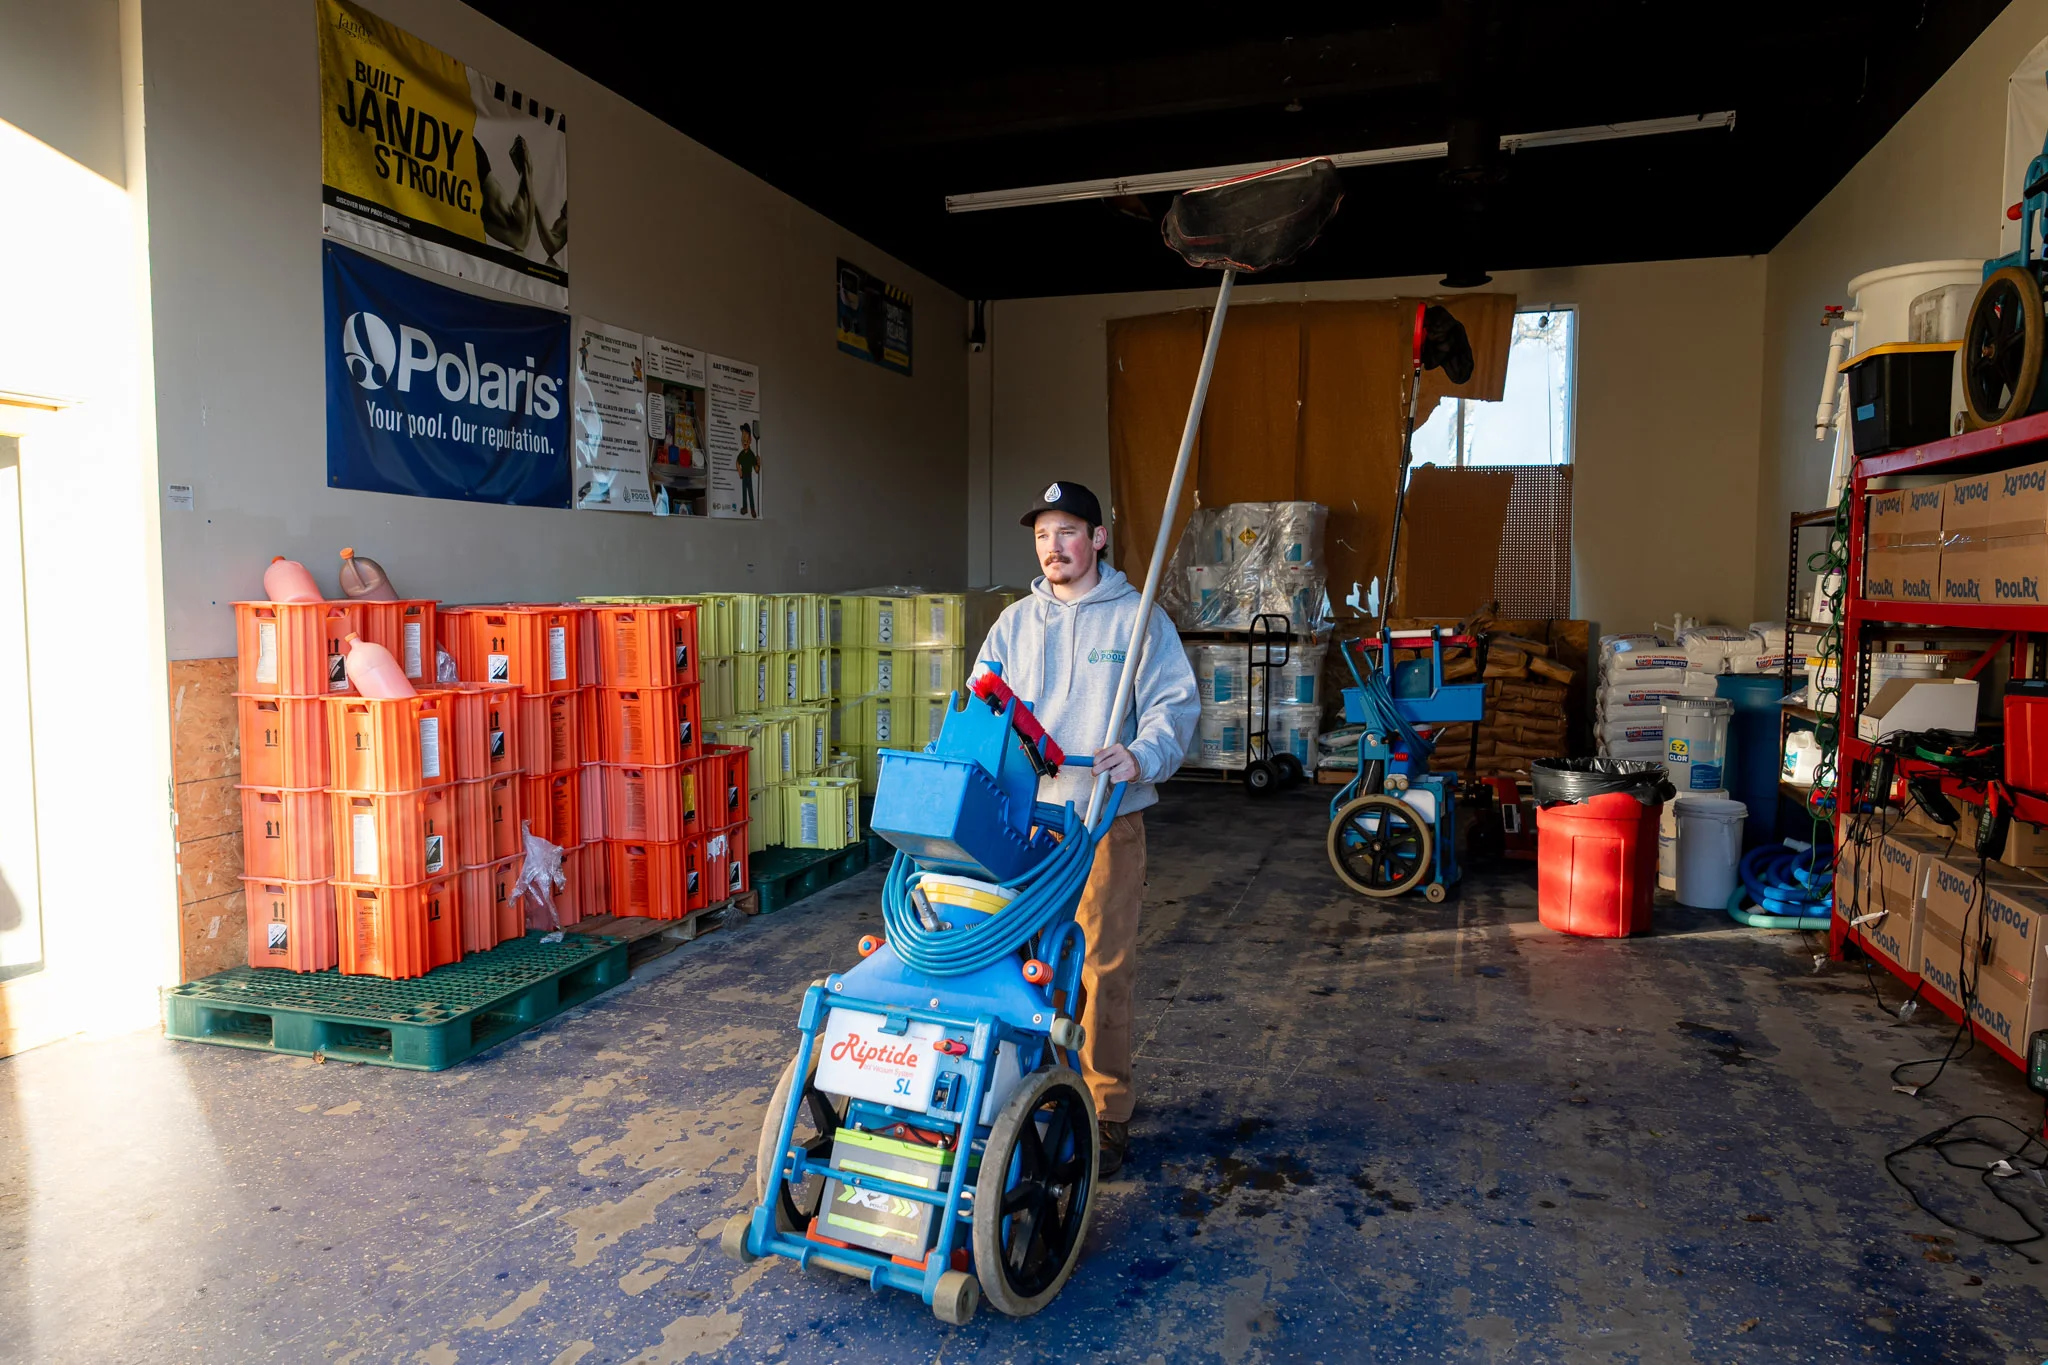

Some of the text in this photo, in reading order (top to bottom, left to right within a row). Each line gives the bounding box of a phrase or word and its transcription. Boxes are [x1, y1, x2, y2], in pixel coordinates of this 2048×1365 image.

[355, 59, 405, 99] BUILT
[337, 78, 463, 172] JANDY
[374, 144, 477, 215] STRONG.
[336, 195, 359, 210] DISCOVER
[359, 203, 370, 214] WHY
[370, 207, 383, 218] PROS
[383, 212, 399, 223] CHOOSE
[712, 362, 721, 371] ARE
[722, 364, 730, 373] YOU
[365, 399, 404, 433] Your
[407, 412, 447, 440] pool.
[451, 415, 478, 444] Our
[481, 424, 555, 455] reputation.
[1101, 653, 1126, 662] POOLS
[1652, 659, 1688, 668] MINI-PELLETS
[1671, 743, 1686, 752] E-Z
[1669, 753, 1688, 762] CLOR
[830, 1032, 919, 1070] Riptide
[895, 1068, 914, 1078] System
[893, 1078, 911, 1096] SL
[869, 1203, 888, 1211] POWER
